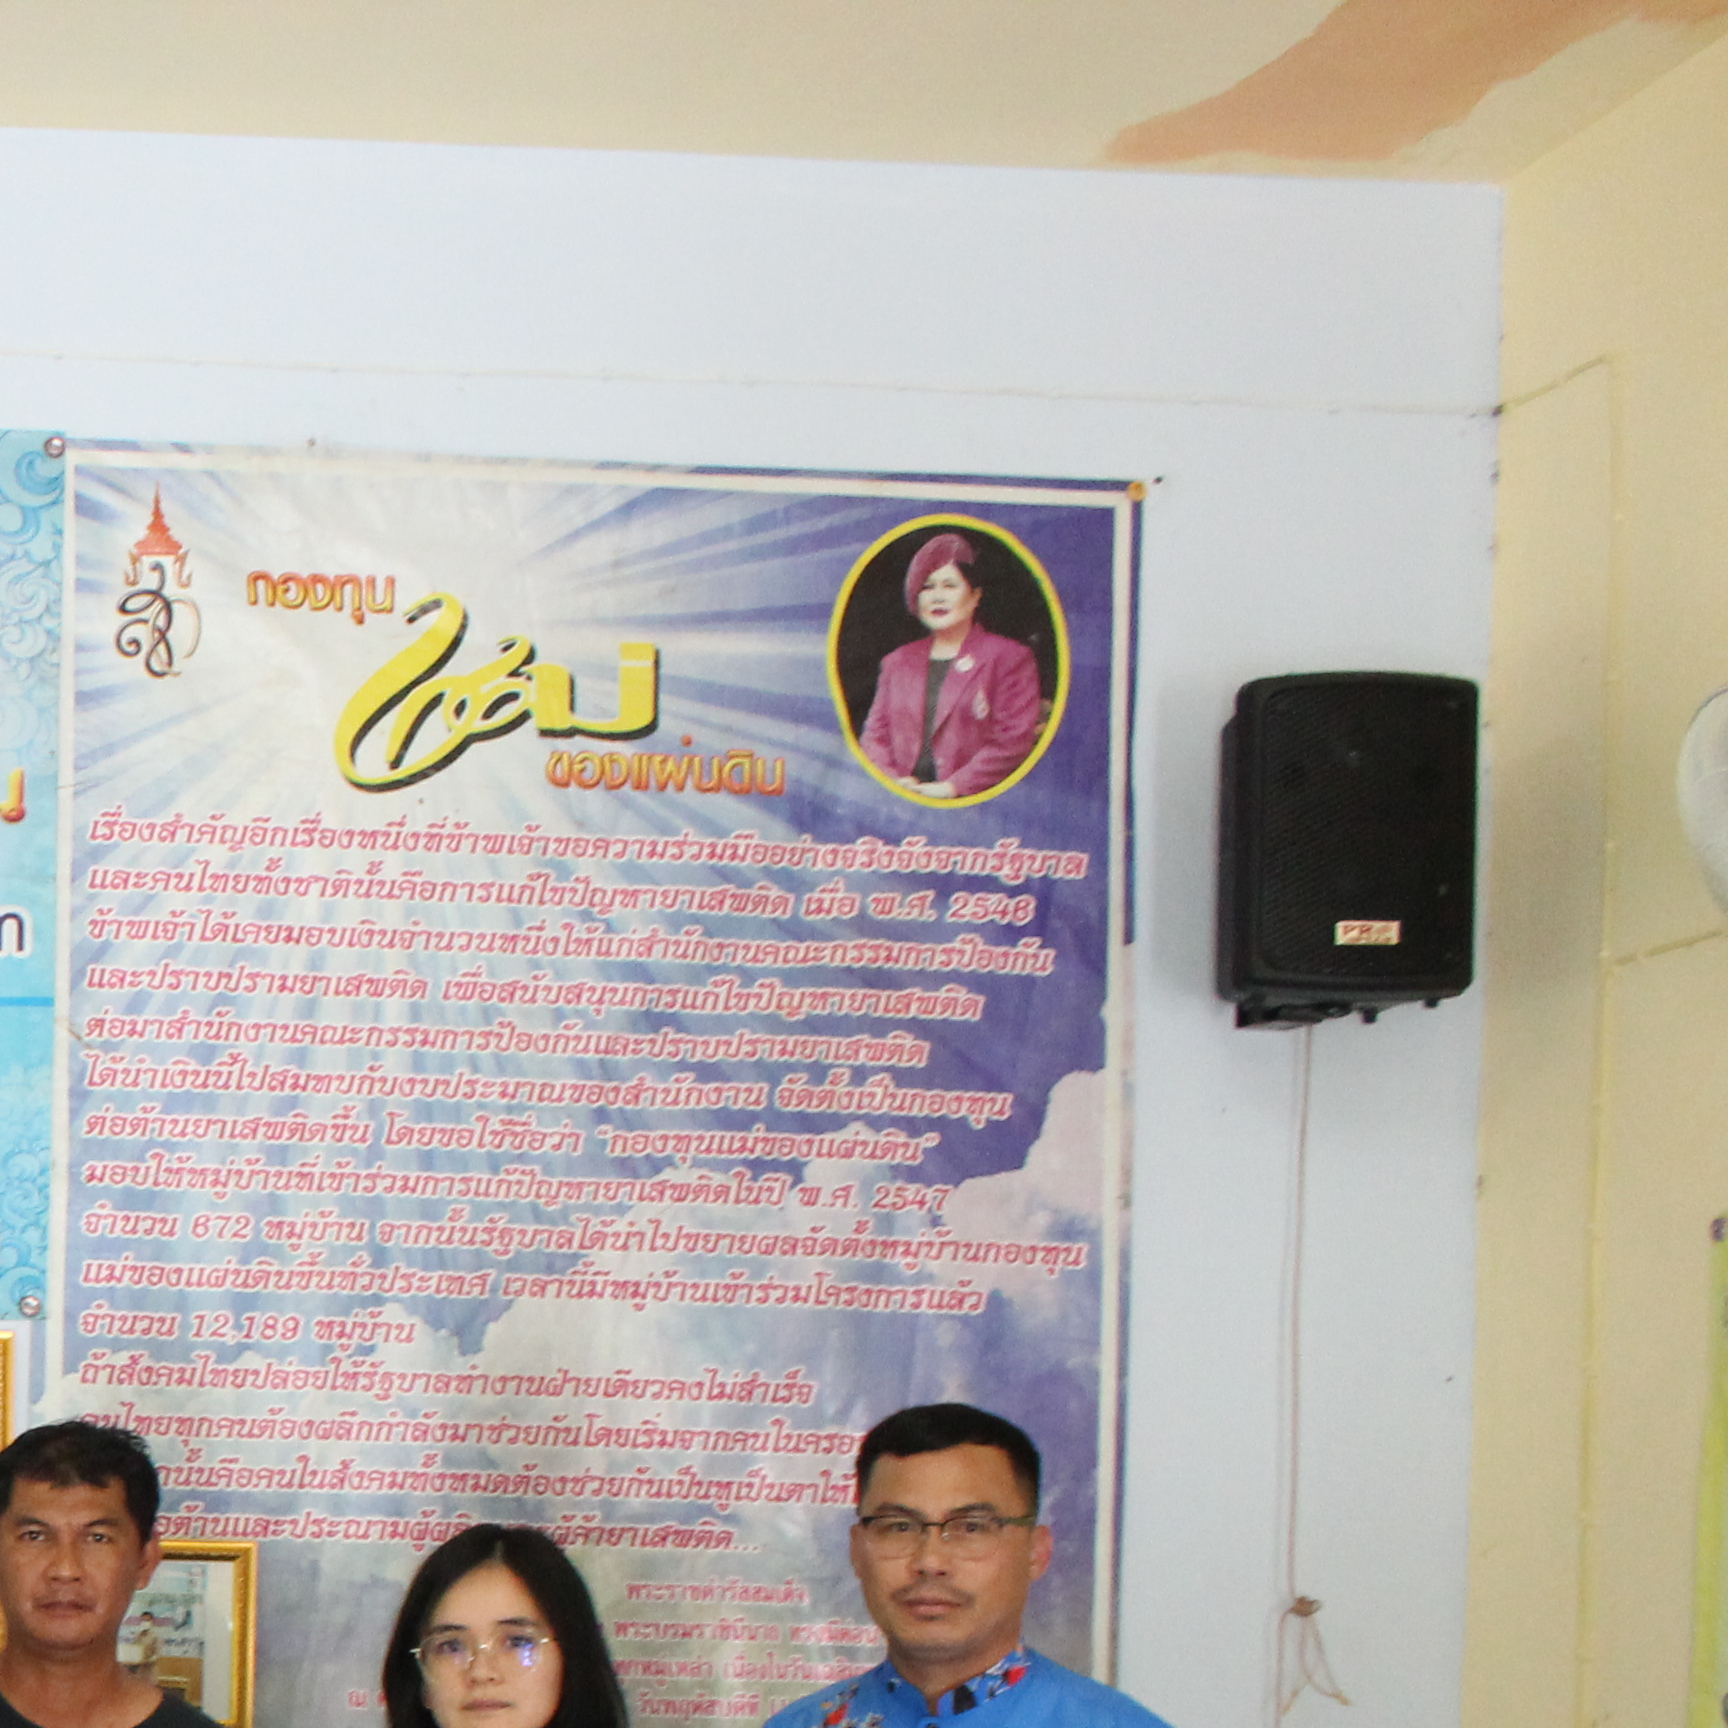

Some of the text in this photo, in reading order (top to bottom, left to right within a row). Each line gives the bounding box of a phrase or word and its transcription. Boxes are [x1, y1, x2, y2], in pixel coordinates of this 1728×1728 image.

[244, 567, 397, 628] กองทุน
[545, 733, 787, 797] ของแผ่นดิน
[83, 1202, 178, 1239] จำนวน
[262, 1209, 368, 1254] หมู่บ้าน
[81, 1302, 178, 1338] จำนวน
[313, 1310, 418, 1353] หมู่บ้าน
